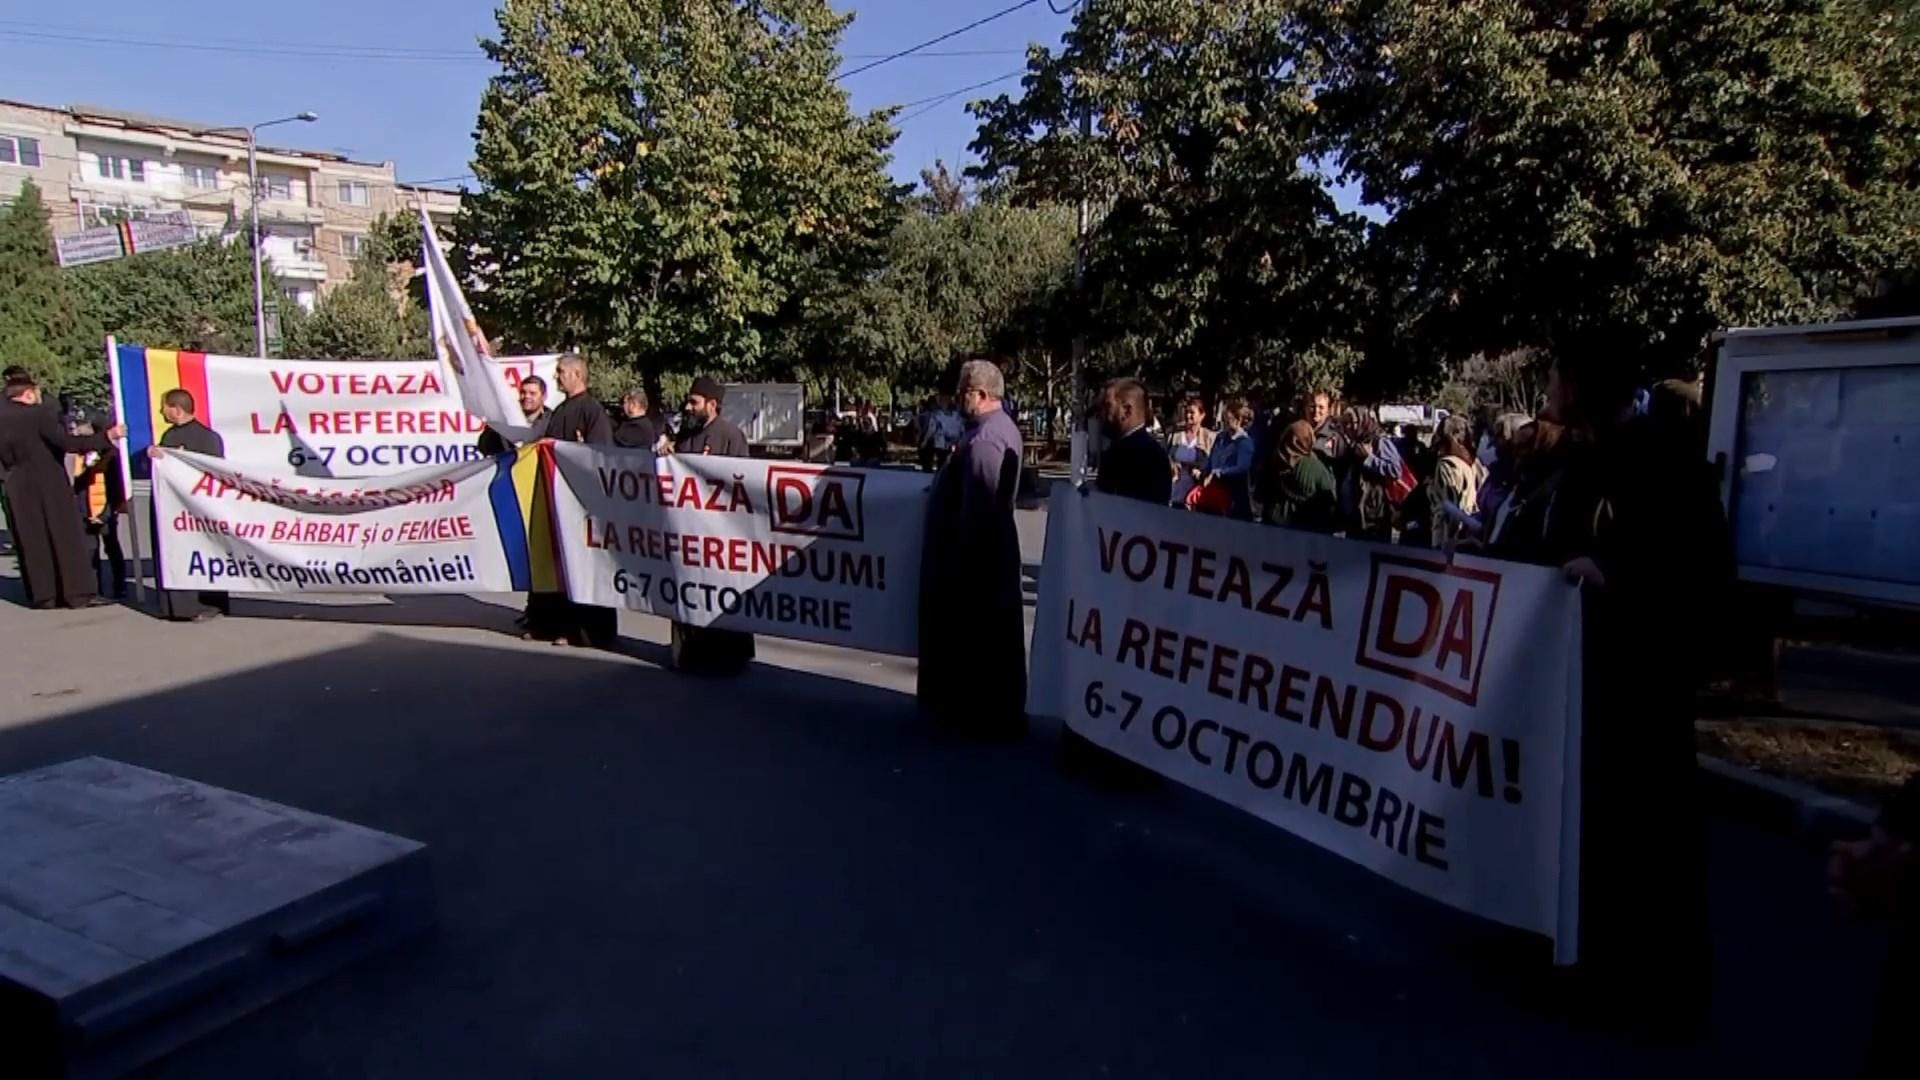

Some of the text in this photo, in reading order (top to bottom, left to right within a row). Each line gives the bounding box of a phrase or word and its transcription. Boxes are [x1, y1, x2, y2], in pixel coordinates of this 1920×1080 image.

[270, 369, 441, 395] VOTEAZĂ
[251, 410, 486, 435] LA REFEREND
[287, 444, 481, 468] 6-7 OCTOMB
[173, 511, 229, 536] dintre
[235, 522, 265, 538] un
[271, 517, 359, 544] BĂRBAT
[381, 528, 394, 542] o
[397, 516, 474, 541] FEMEIE
[599, 467, 854, 530] VOTEAZĂ DA
[188, 551, 475, 588] Apără copiii României!
[586, 519, 886, 590] LA REFERENDUM!
[613, 569, 852, 631] 6-7 OCTOMBRIE
[1098, 527, 1475, 681] VOTEAZĂ DA
[1066, 597, 1524, 804] LA REFERENDUM!
[1084, 680, 1449, 871] 6-7 OCTOMBRIE
